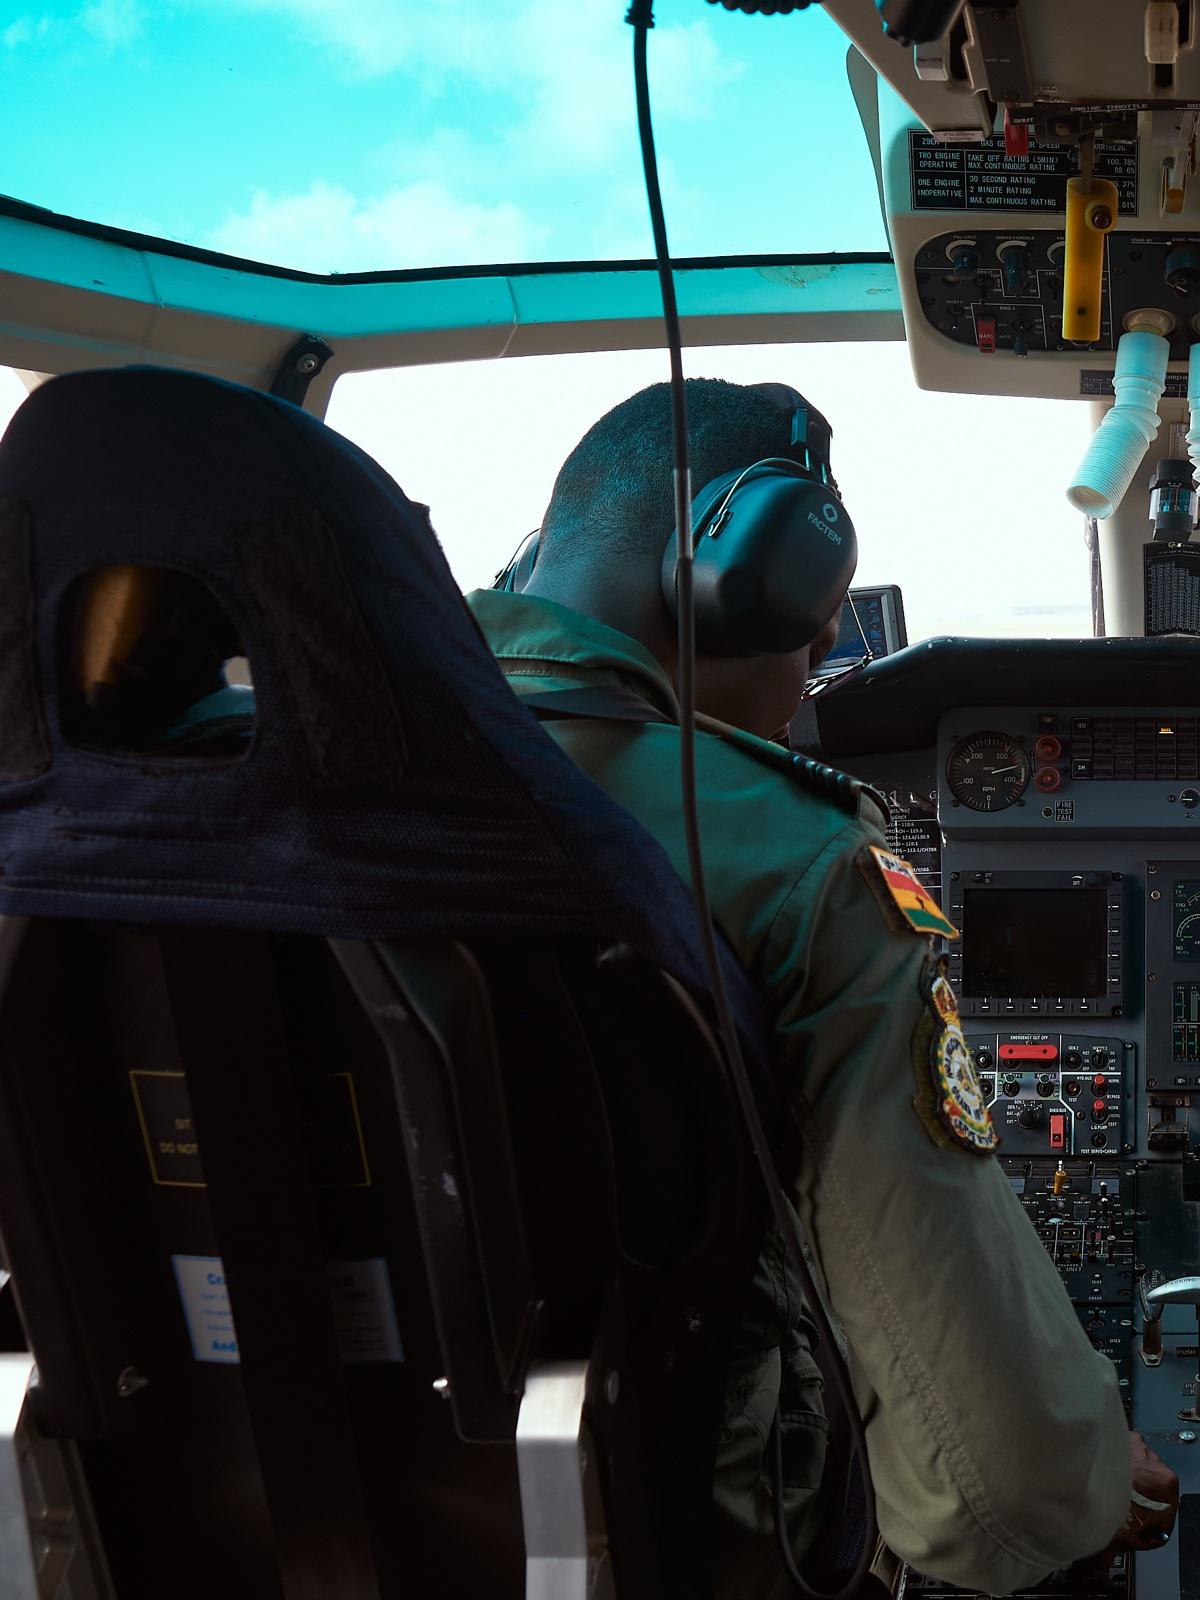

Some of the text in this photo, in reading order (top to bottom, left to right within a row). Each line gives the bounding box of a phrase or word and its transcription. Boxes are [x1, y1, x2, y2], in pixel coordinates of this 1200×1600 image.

[1105, 103, 1148, 111] THROTTLE
[980, 140, 994, 148] GAS
[918, 151, 961, 160] TWO ENGINE
[967, 154, 984, 162] TAKE
[1003, 155, 1030, 163] RATING
[919, 160, 958, 169] OPERATIVE
[984, 162, 1027, 170] CONTINUOUS
[1029, 163, 1056, 171] RATING
[917, 178, 961, 187] ONE ENGINE
[969, 175, 1036, 184] 30 SECOND RATING
[917, 188, 963, 198] INOPERATIVE
[977, 186, 1004, 194] MINUTE
[1006, 187, 1032, 195] RATING
[985, 197, 1028, 205] CONTINUOUS
[1030, 198, 1057, 206] RATING
[806, 511, 843, 546] FACTEM
[970, 752, 984, 760] 200
[995, 752, 1008, 760] 300
[962, 777, 974, 785] 100
[1003, 776, 1016, 784] 400
